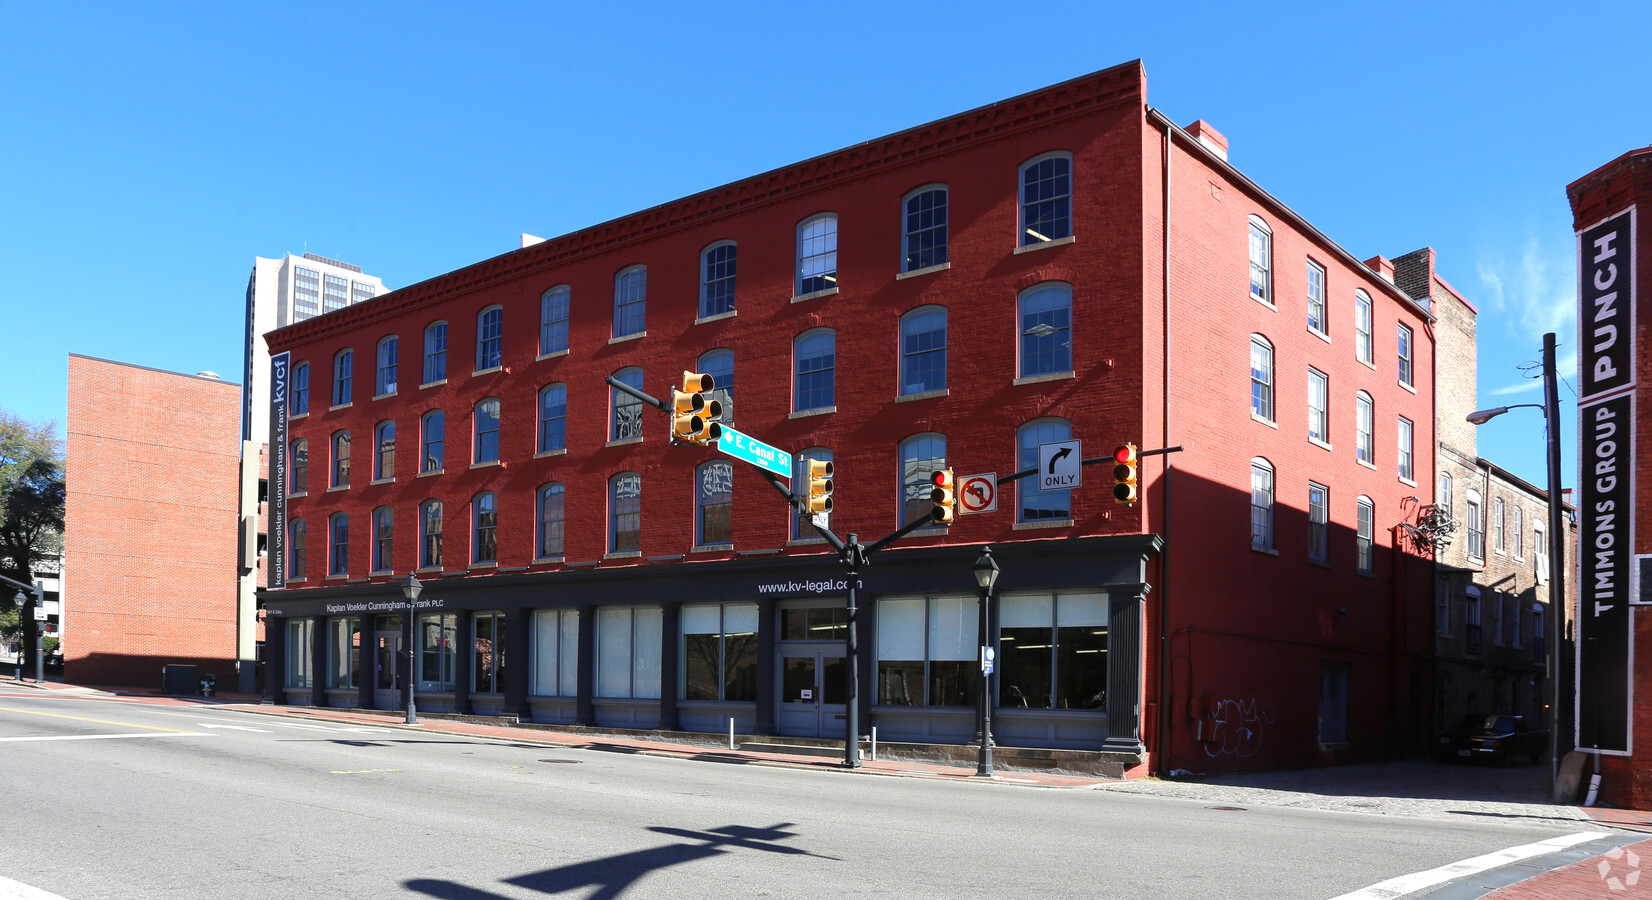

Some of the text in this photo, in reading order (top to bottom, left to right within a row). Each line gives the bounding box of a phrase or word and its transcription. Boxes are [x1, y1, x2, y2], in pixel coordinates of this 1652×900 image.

[1594, 230, 1617, 382] PUNCH
[273, 360, 285, 403] kvcf
[277, 434, 283, 442] &
[735, 434, 789, 467] E. Canal St
[276, 444, 284, 508] cunningham
[1045, 474, 1075, 486] ONLY
[1594, 407, 1616, 617] TIMMONS GROUP
[275, 550, 283, 585] kaplan
[326, 604, 346, 613] Kaplan
[346, 602, 367, 611] Voekler
[368, 601, 405, 611] Cunningham
[413, 599, 430, 607] rank
[431, 599, 444, 607] PLC
